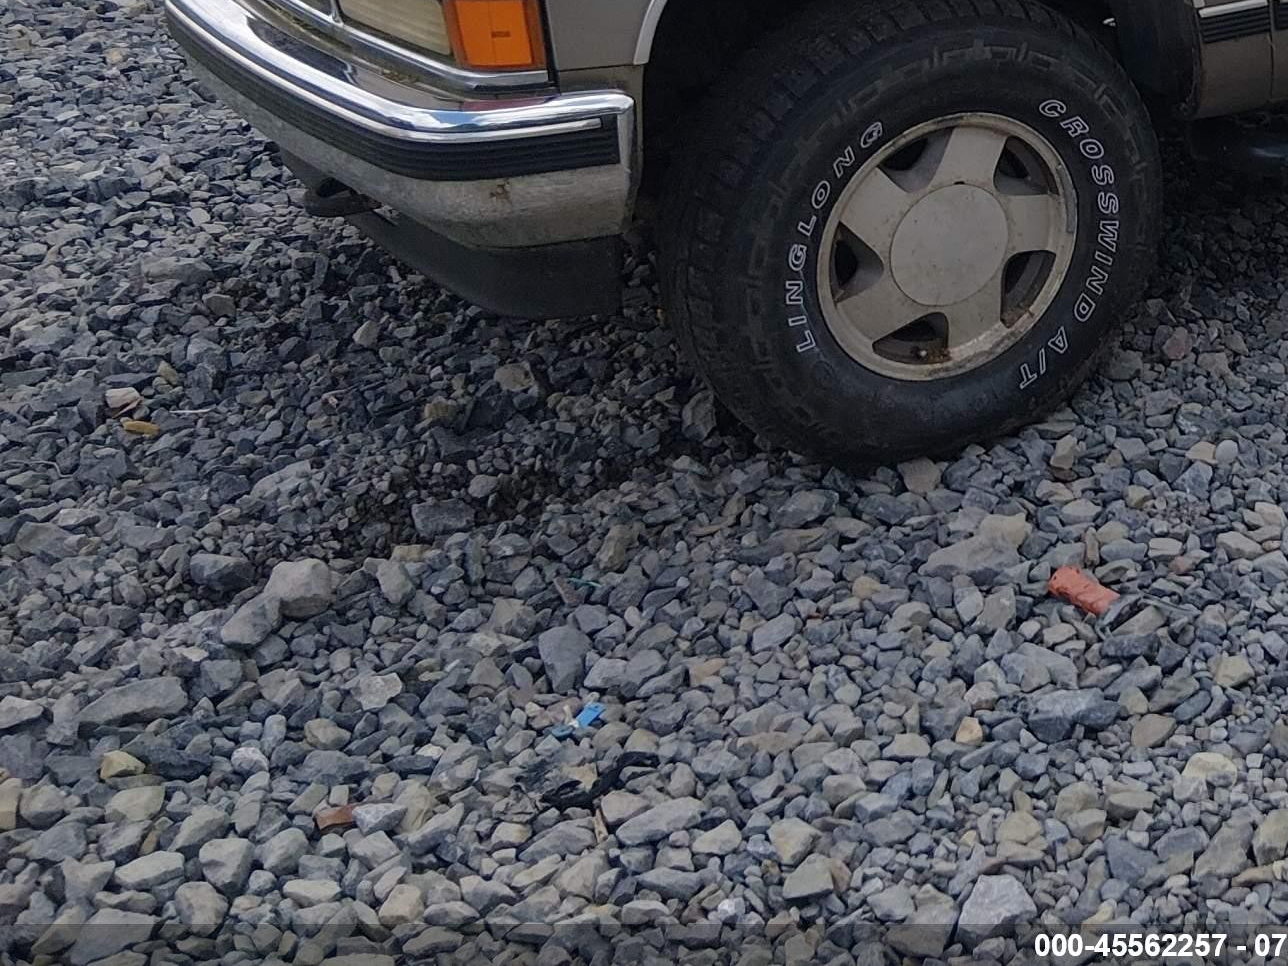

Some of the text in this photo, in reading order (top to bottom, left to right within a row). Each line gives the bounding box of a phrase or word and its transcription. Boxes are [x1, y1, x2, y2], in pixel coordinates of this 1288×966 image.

[785, 121, 884, 354] LINGLONG
[1019, 98, 1120, 390] CROSSWIND A/T
